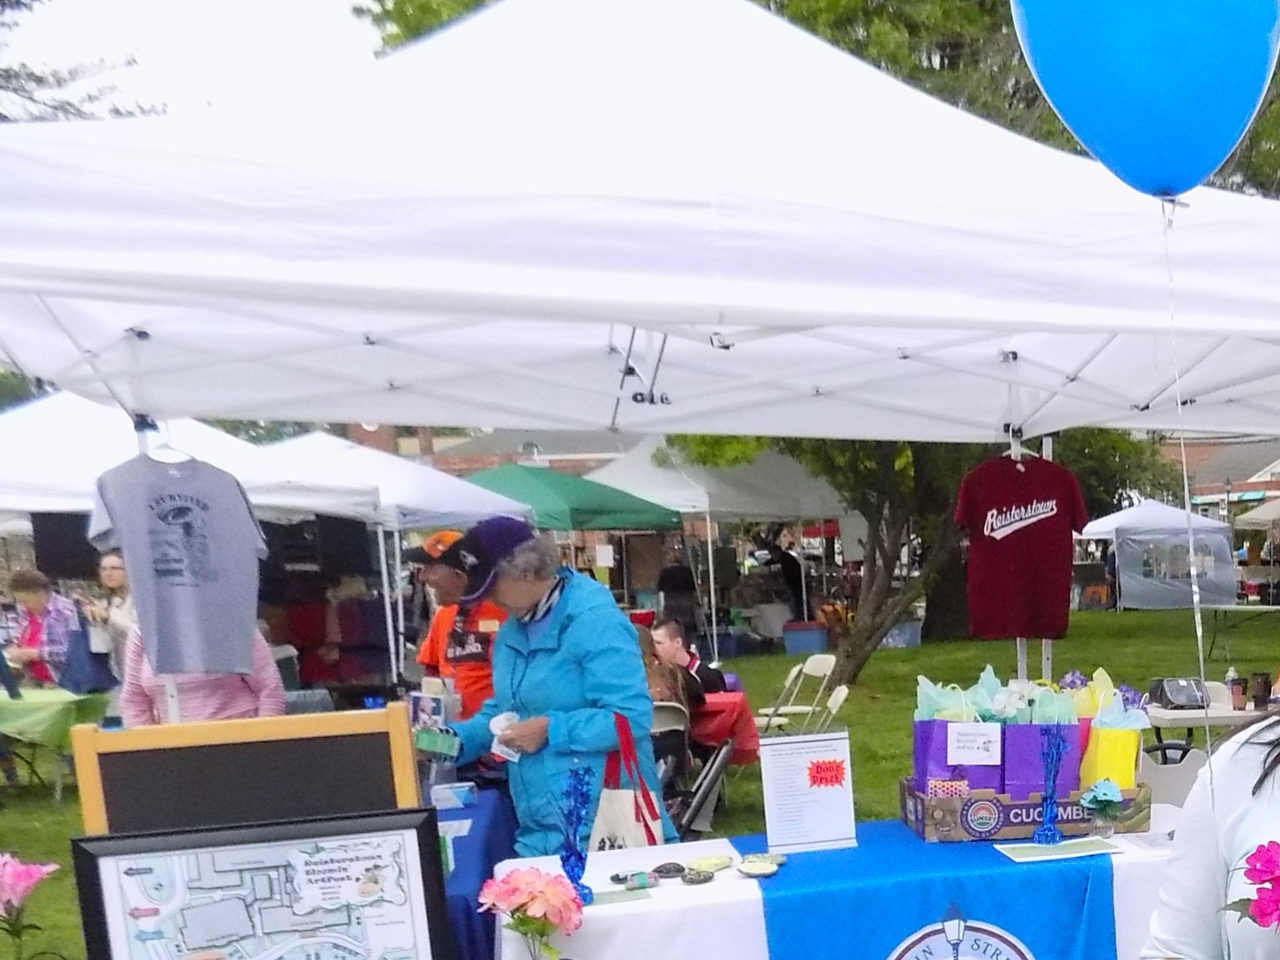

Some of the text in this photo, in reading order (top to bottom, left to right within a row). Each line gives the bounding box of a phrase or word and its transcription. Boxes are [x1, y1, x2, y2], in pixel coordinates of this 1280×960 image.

[984, 499, 1058, 535] Reisterstown
[816, 765, 840, 774] Door
[1009, 806, 1093, 823] CUCMBE
